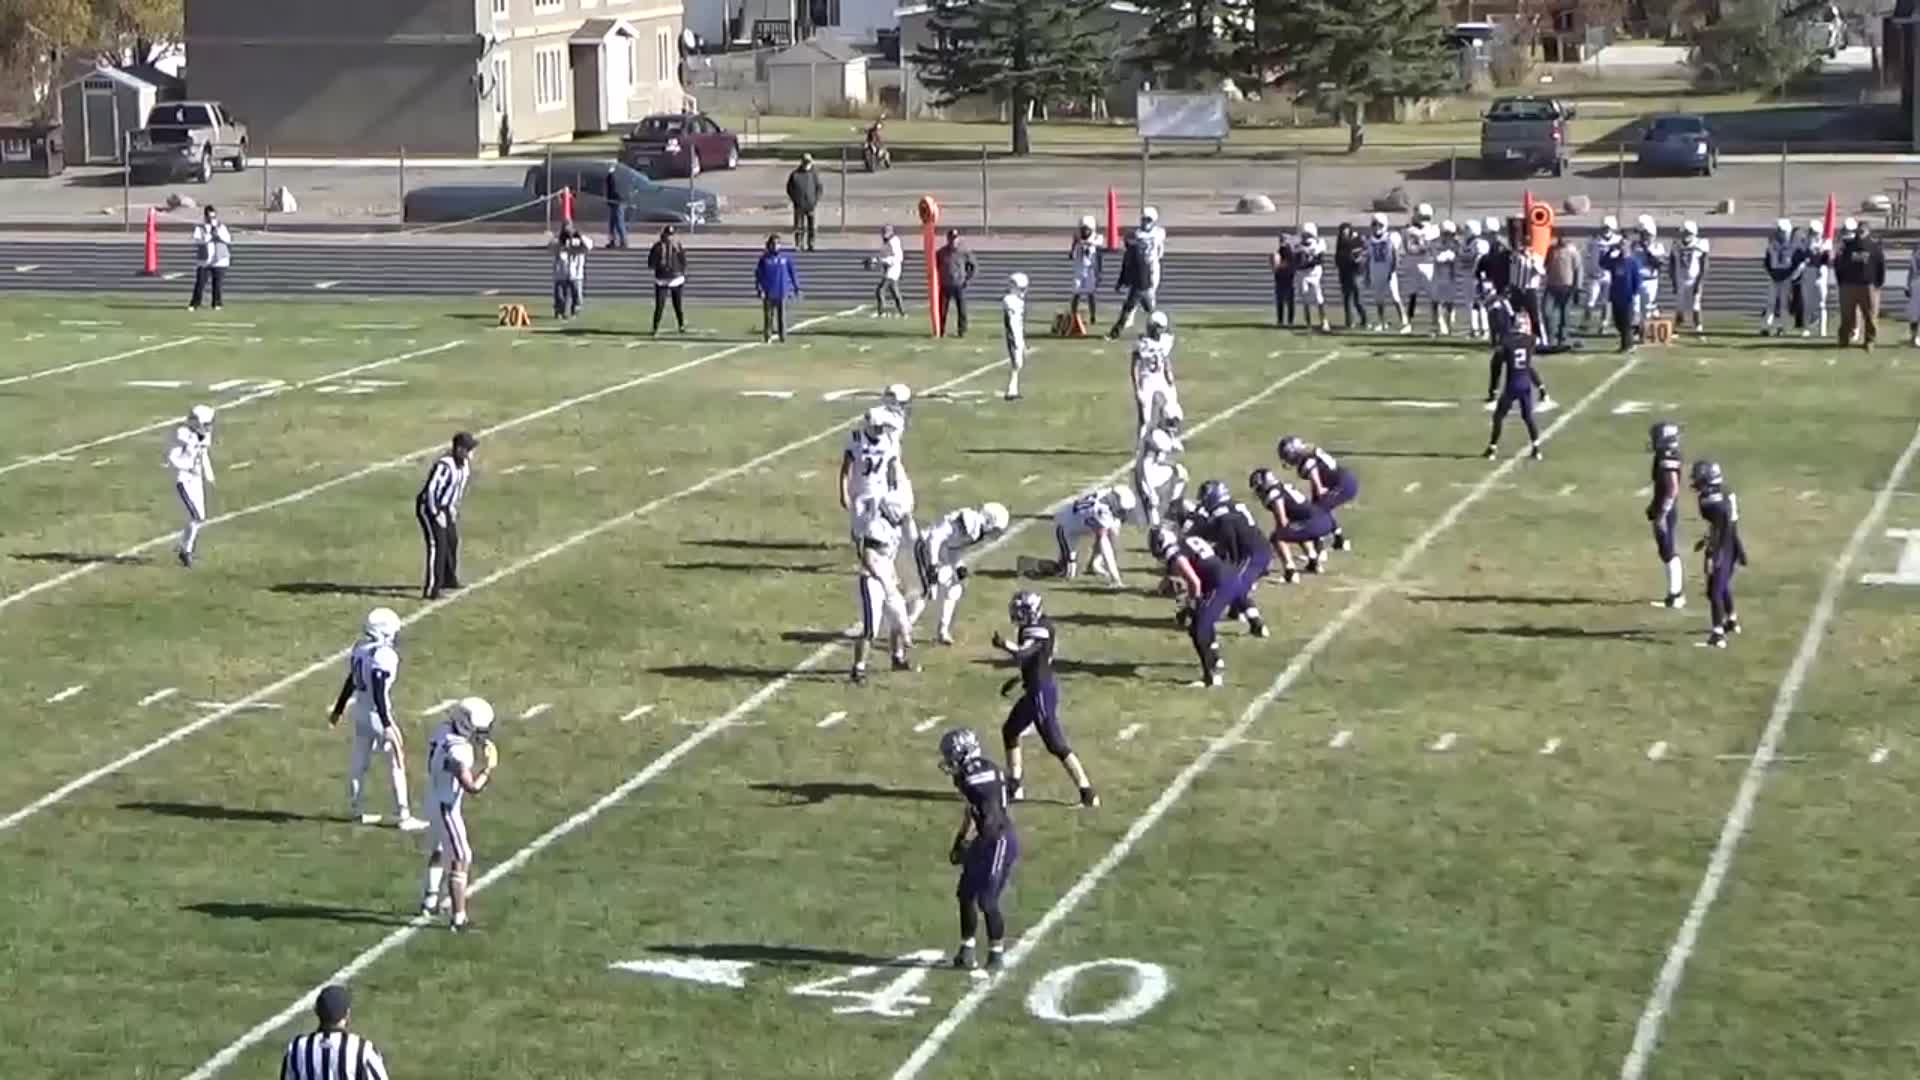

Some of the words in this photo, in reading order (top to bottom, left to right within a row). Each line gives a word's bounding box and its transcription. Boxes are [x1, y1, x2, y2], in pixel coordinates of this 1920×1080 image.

[499, 305, 519, 327] 20
[1645, 323, 1668, 344] 40
[1514, 348, 1527, 369] 2
